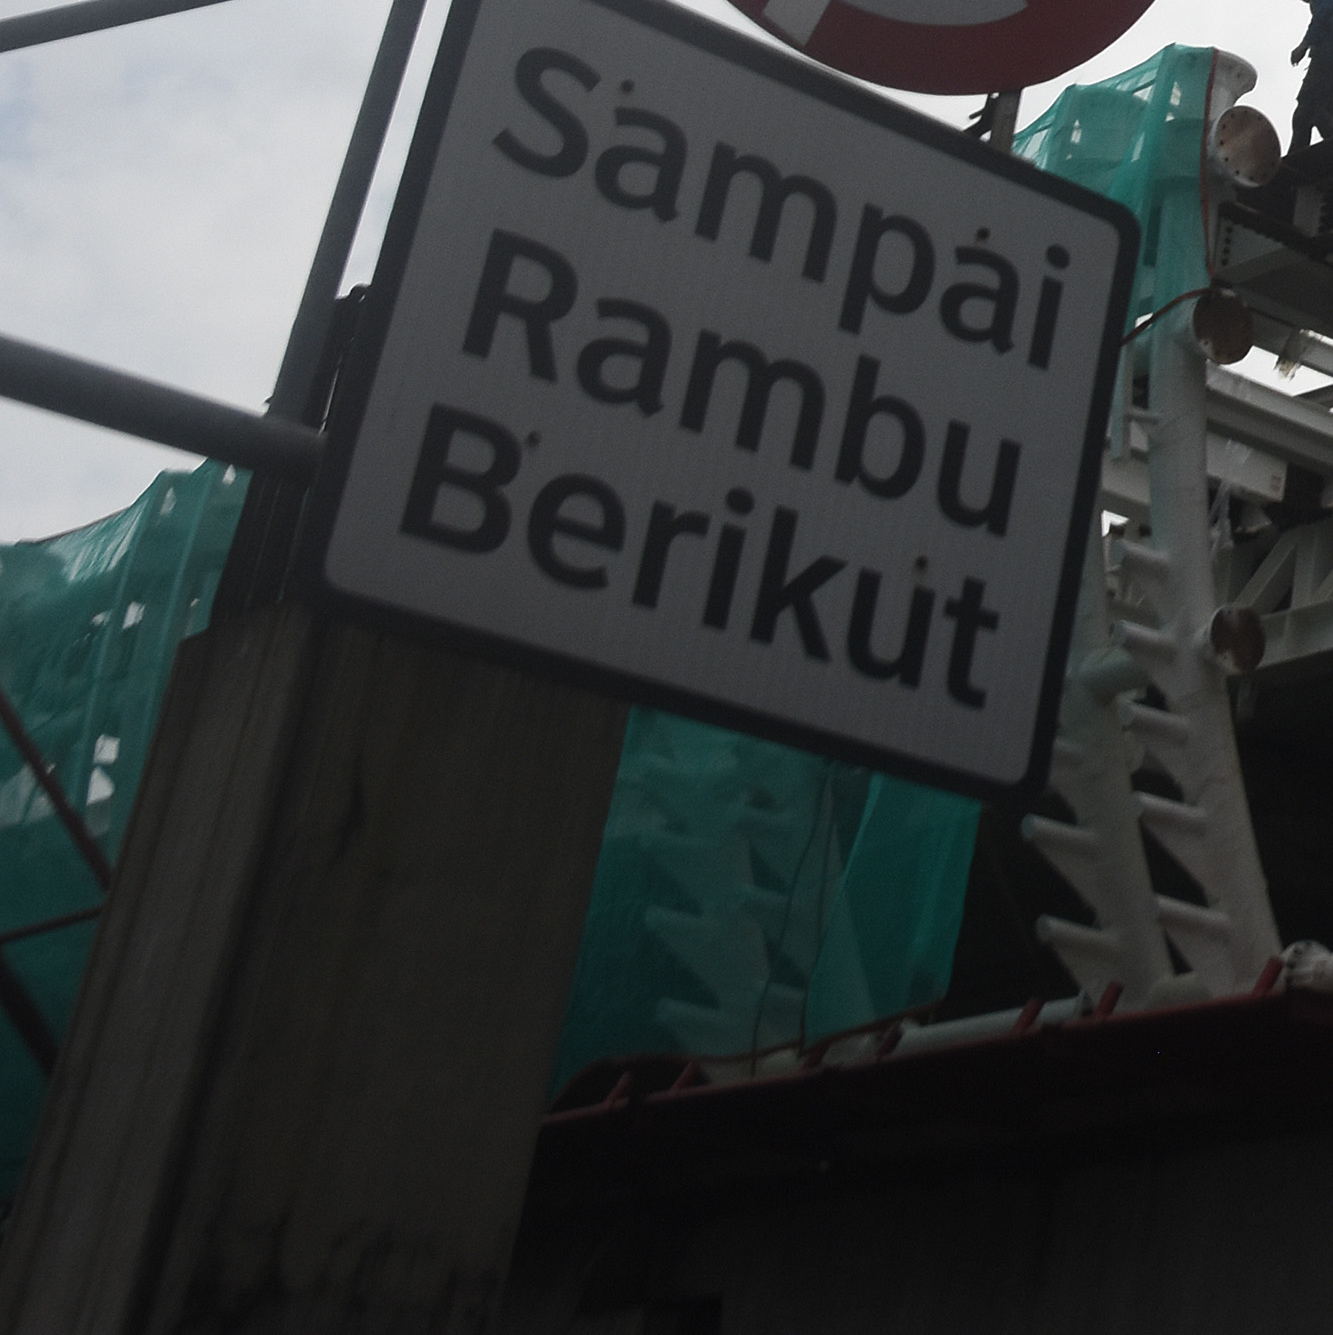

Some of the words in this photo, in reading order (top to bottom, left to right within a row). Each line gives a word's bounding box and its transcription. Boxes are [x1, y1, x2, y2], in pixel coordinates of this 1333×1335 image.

[491, 46, 1072, 370] Sampai
[462, 227, 1022, 539] Rambu
[398, 402, 1000, 711] Berikut
